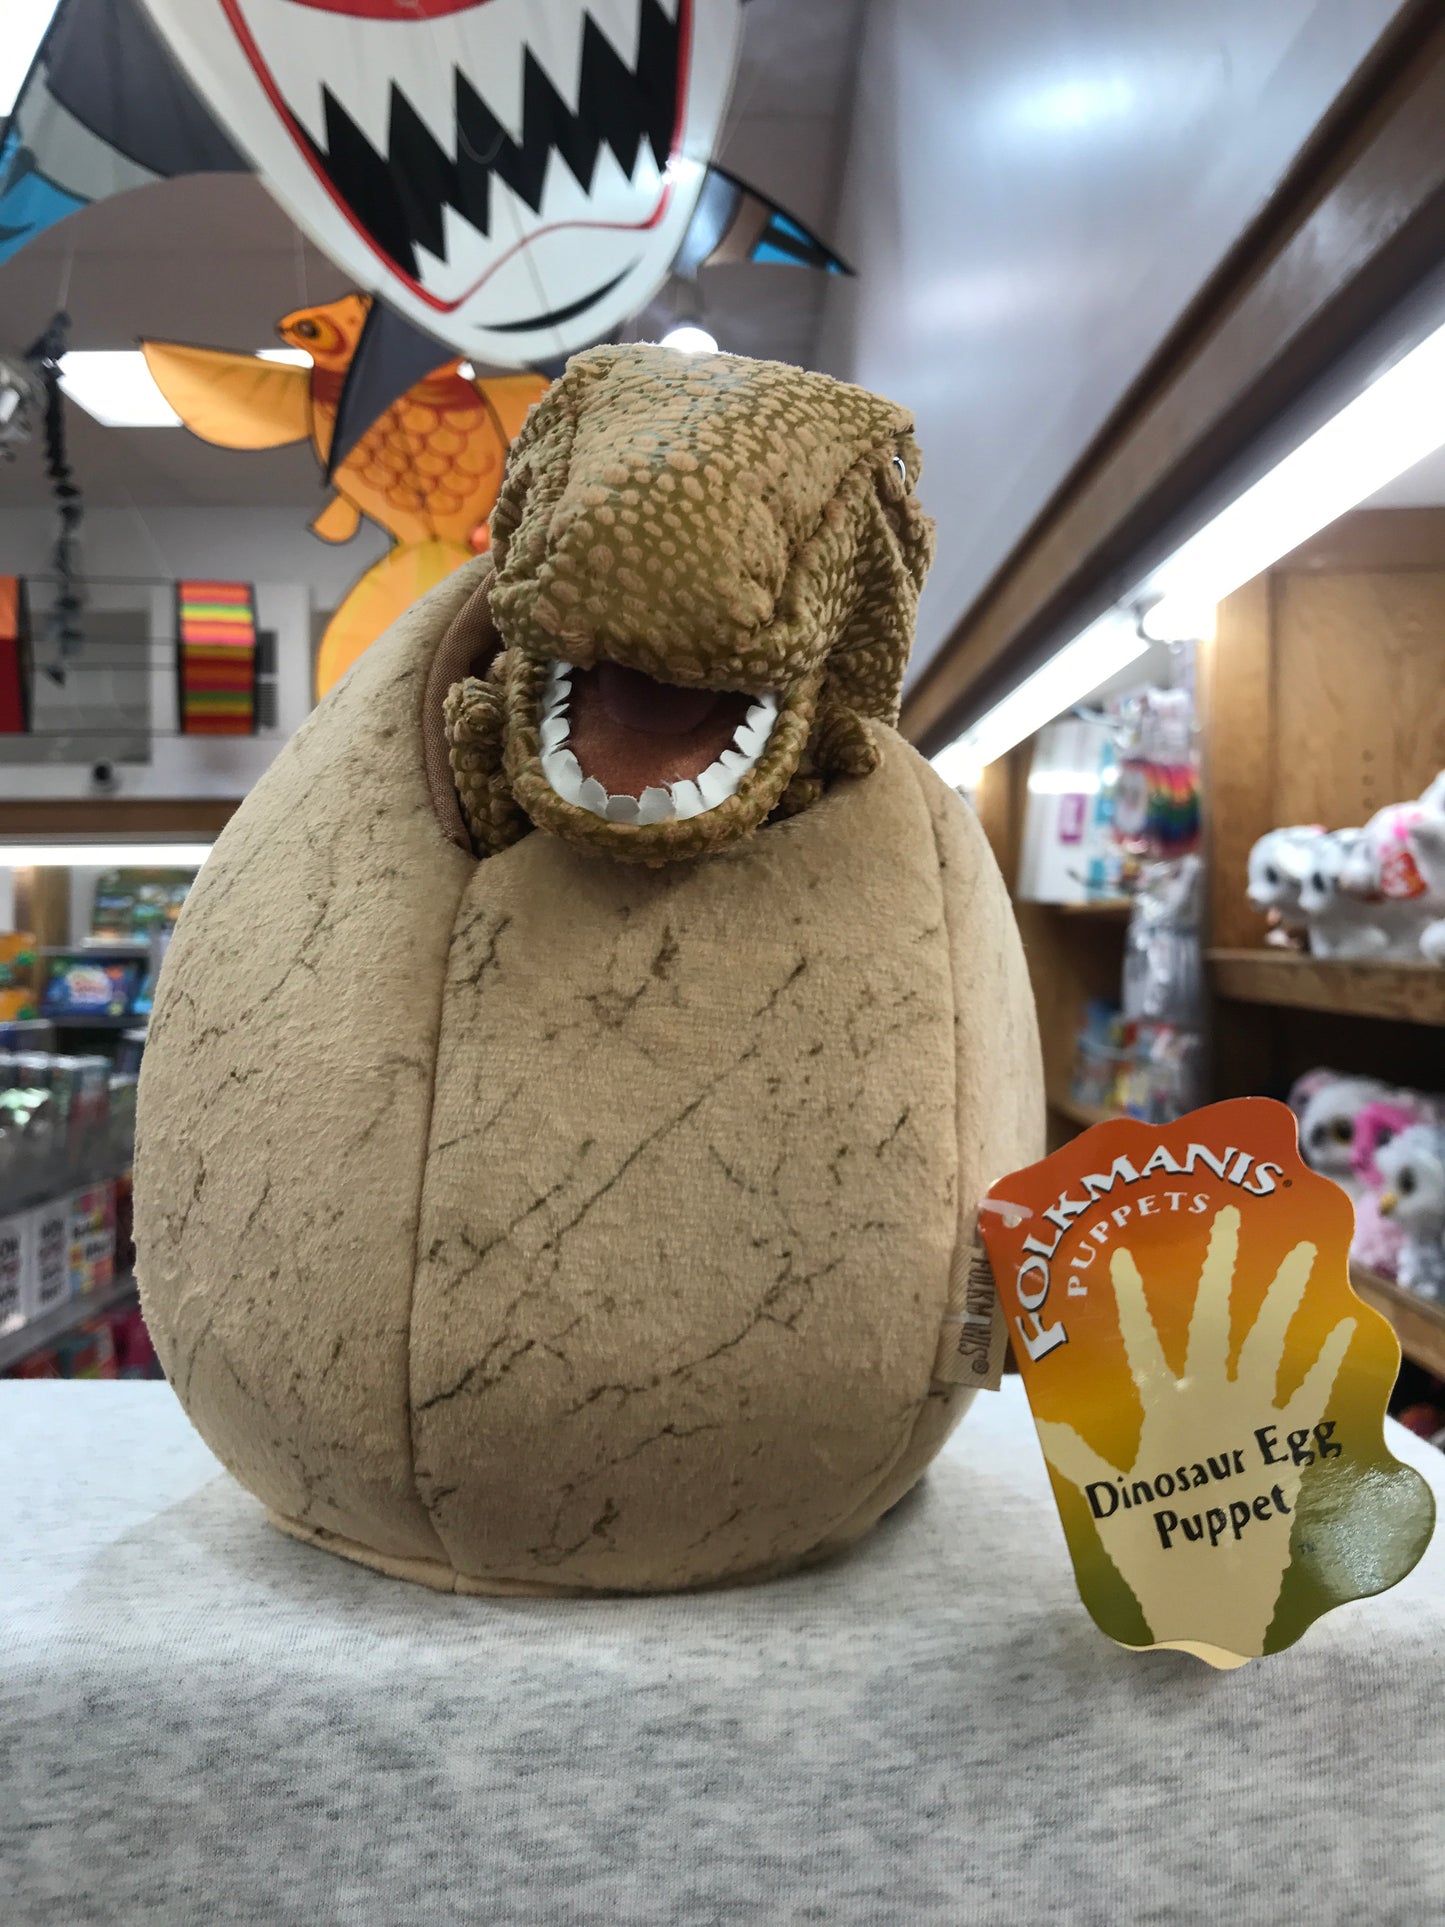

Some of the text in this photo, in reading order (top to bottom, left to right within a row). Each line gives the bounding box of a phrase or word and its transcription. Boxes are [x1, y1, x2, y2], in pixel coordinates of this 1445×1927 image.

[1067, 1191, 1210, 1297] PUPPETS
[1085, 1421, 1342, 1519] Dinosaur Egg
[1153, 1484, 1291, 1549] Puppet
